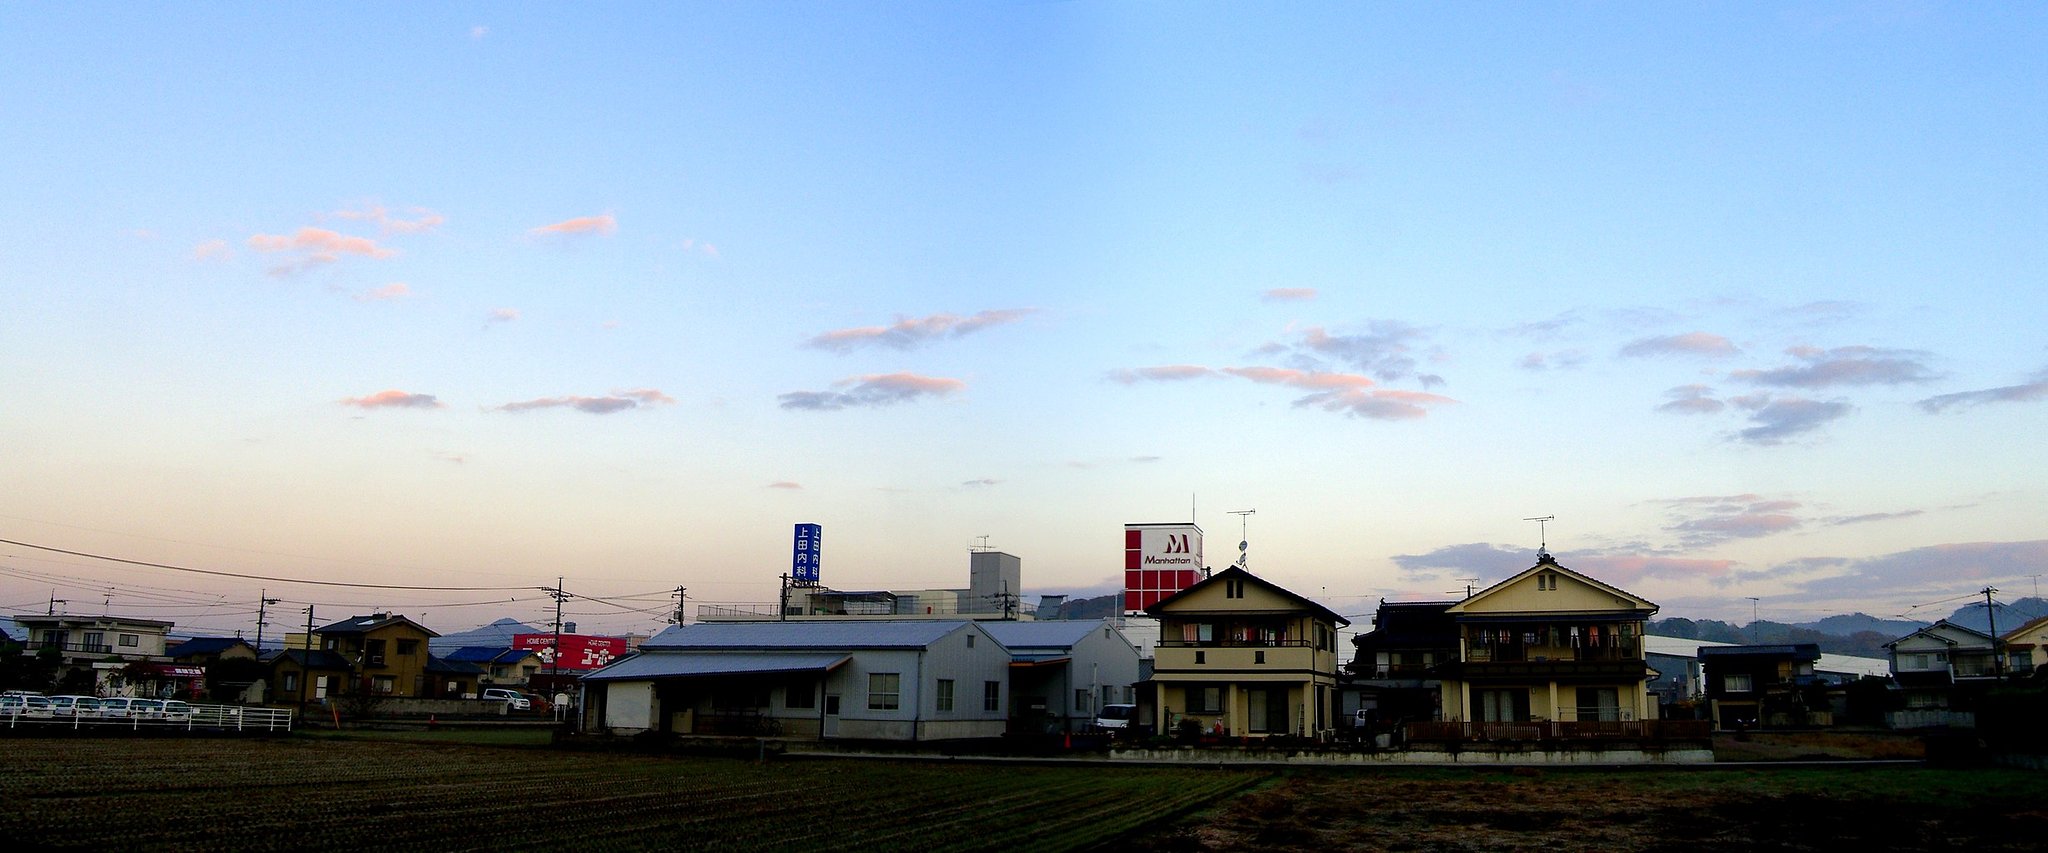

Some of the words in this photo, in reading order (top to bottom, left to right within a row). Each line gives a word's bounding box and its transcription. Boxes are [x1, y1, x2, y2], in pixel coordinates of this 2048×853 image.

[796, 527, 808, 577] 上田内科
[1145, 555, 1190, 565] Manhattan
